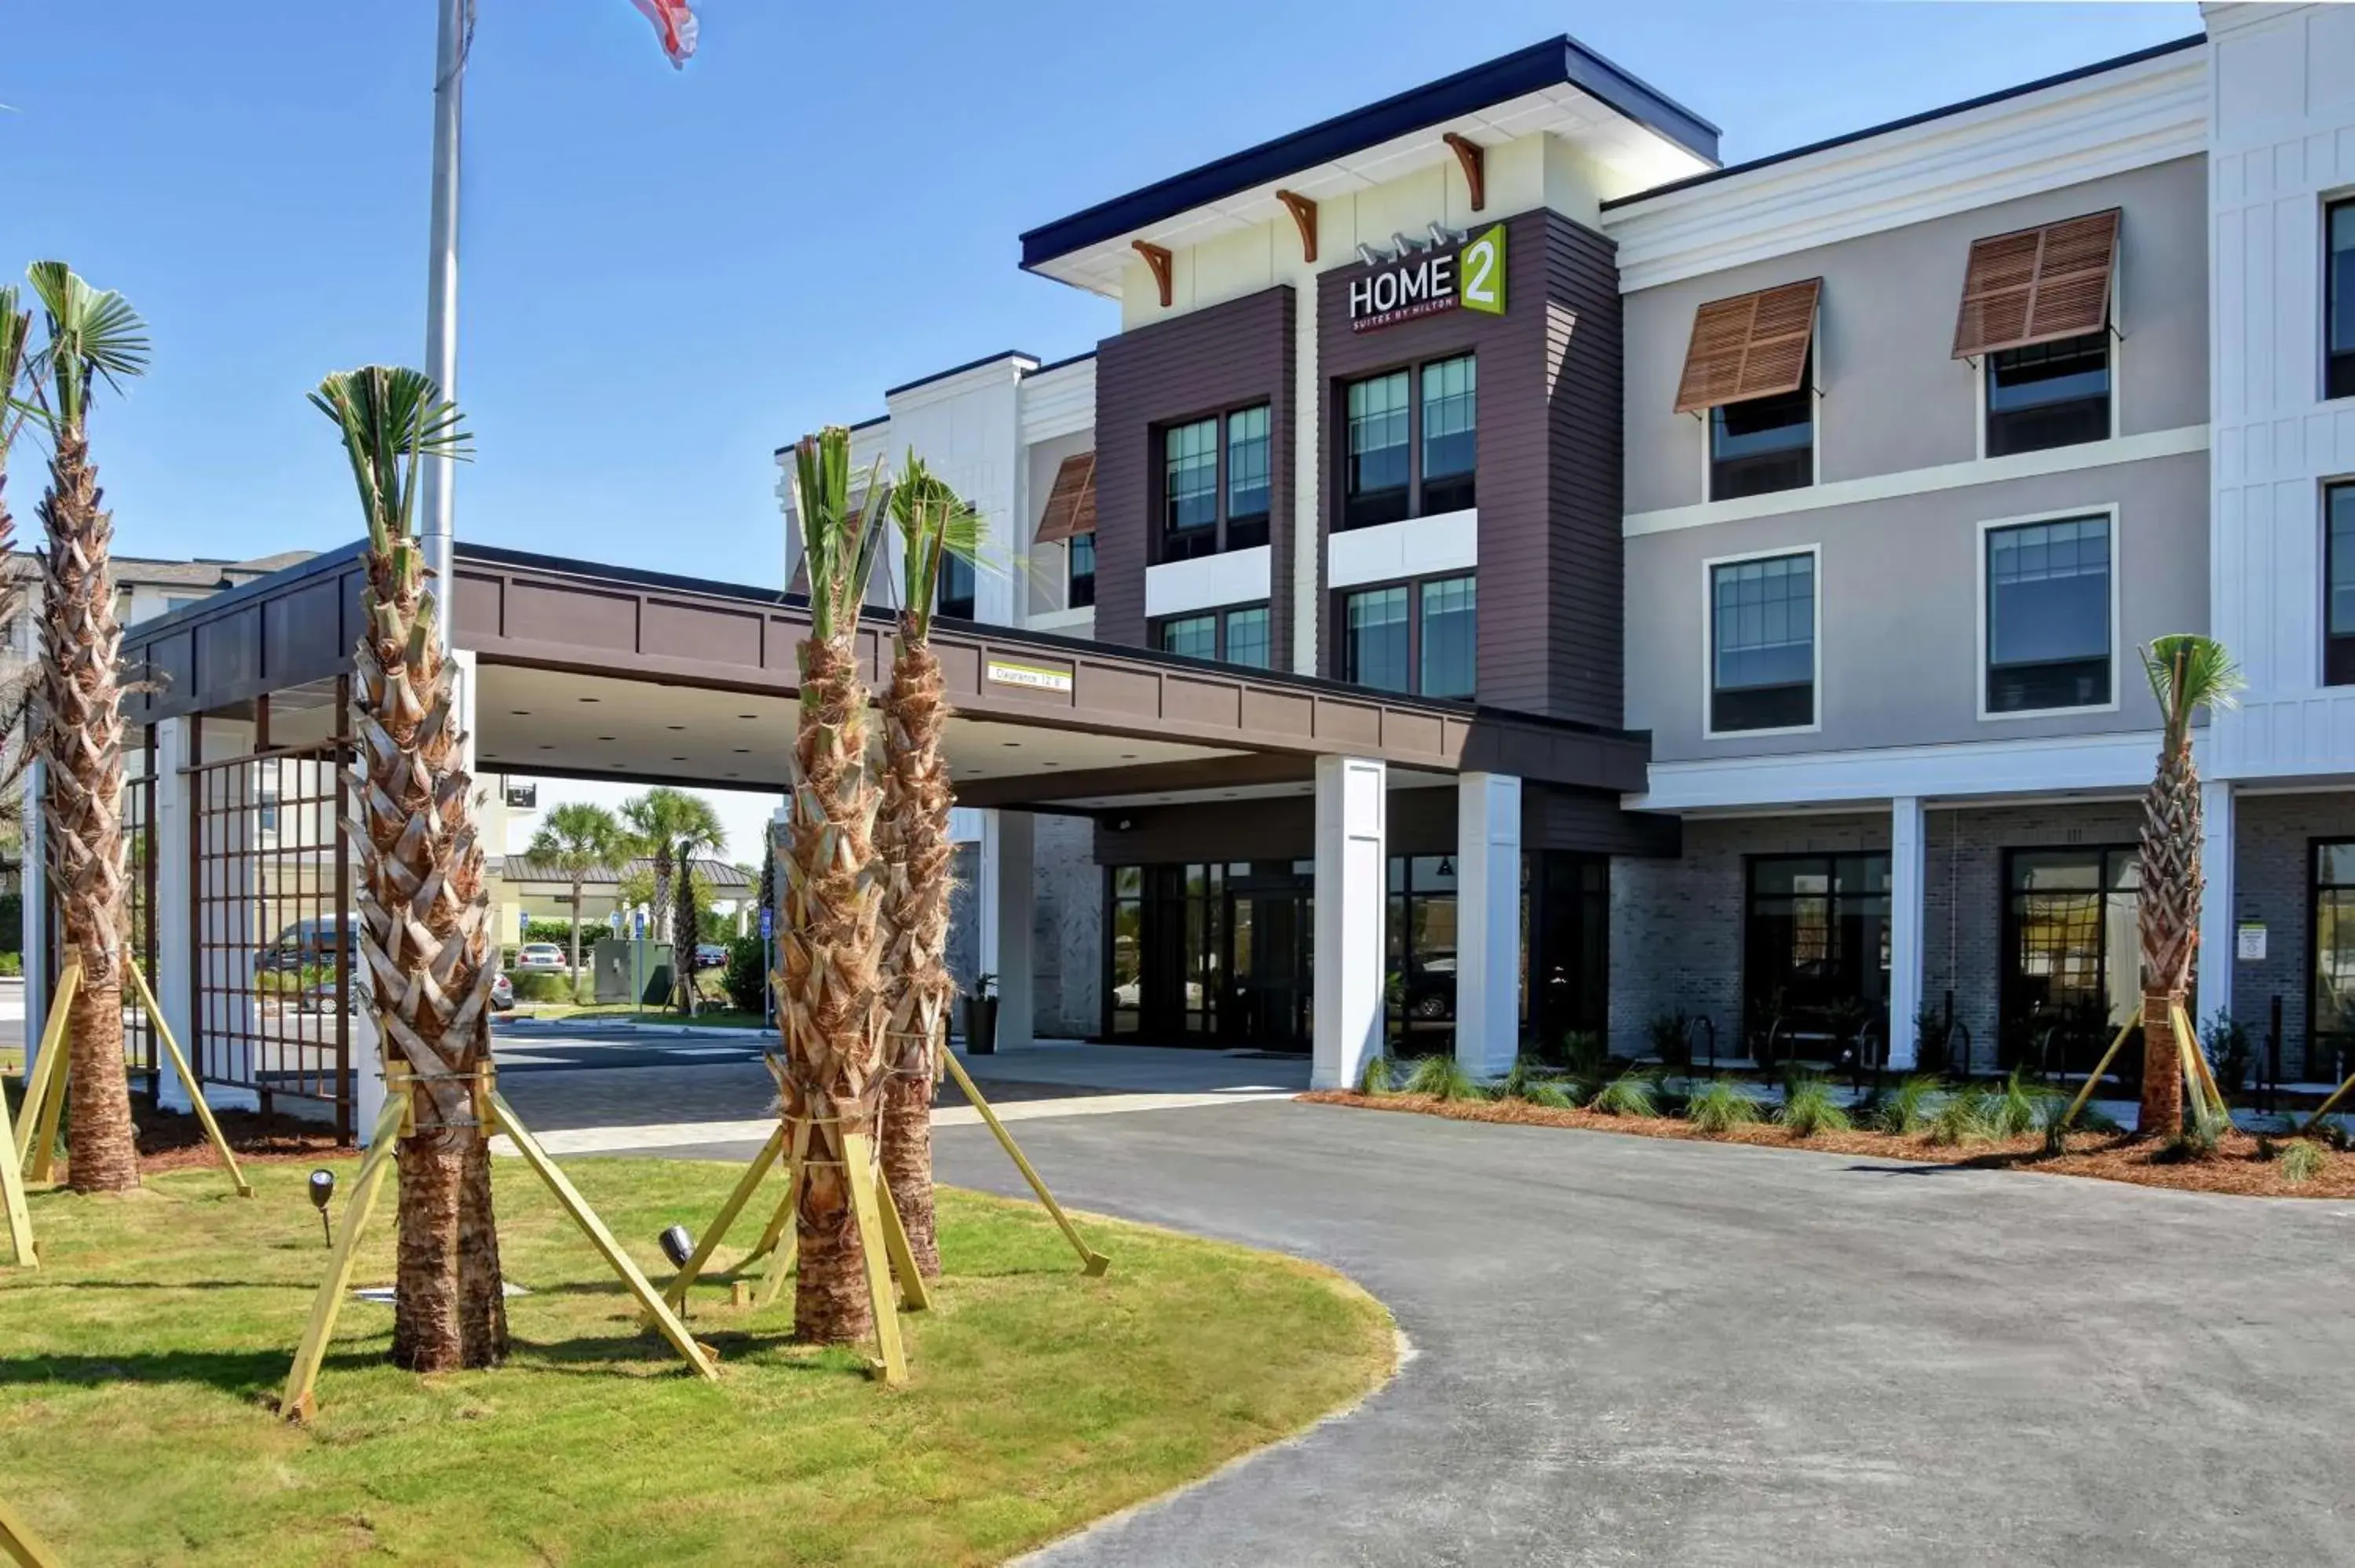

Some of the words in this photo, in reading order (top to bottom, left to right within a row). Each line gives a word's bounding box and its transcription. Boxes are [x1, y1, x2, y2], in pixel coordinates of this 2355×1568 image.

[1350, 254, 1453, 318] HOME
[1466, 241, 1495, 302] 2
[1353, 314, 1390, 330] SUITES
[1395, 309, 1410, 319] BY
[1412, 298, 1452, 315] HILTON
